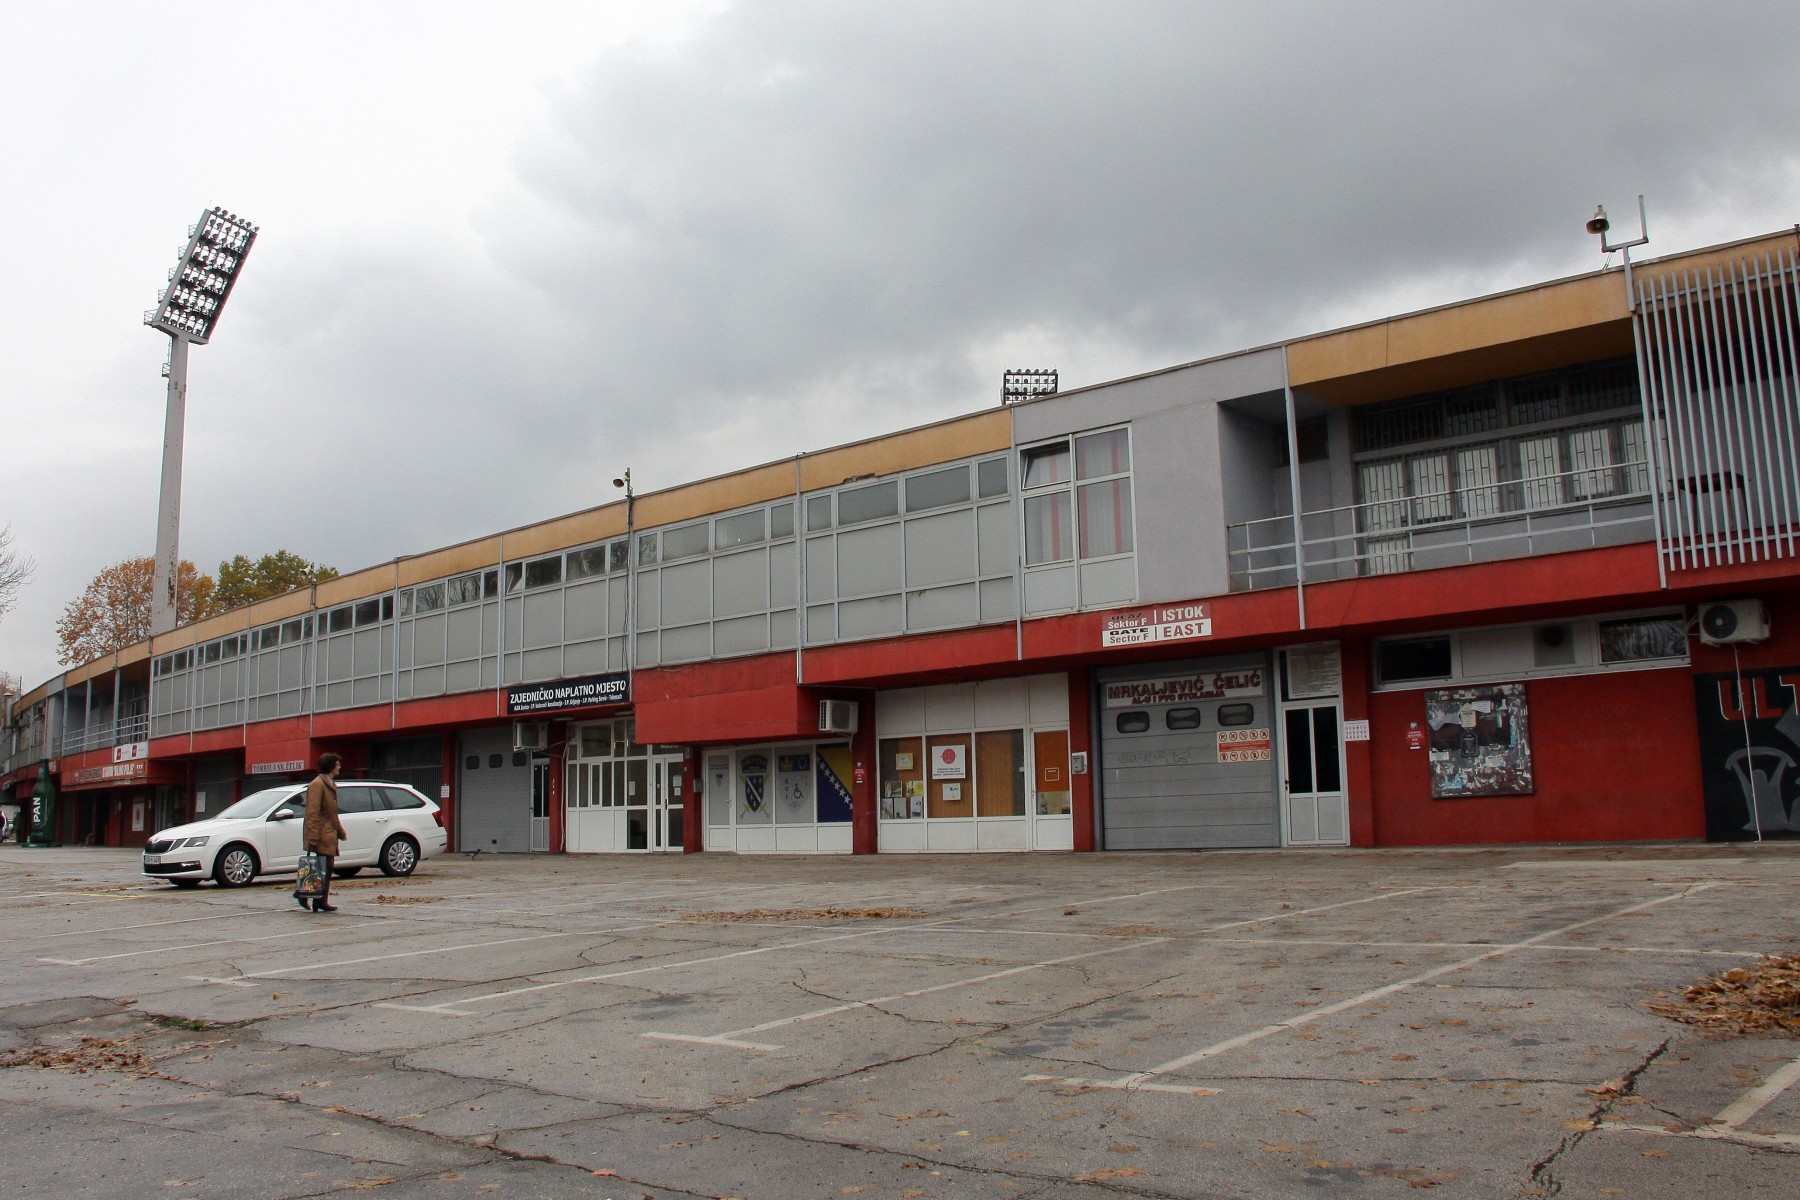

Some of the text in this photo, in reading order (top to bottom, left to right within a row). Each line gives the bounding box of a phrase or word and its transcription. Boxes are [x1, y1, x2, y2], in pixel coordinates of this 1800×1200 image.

[1162, 605, 1204, 622] ISTOK
[1107, 617, 1147, 630] Sektor F
[1109, 627, 1149, 636] GATE
[1163, 622, 1204, 638] EAST
[1109, 632, 1149, 644] Sector F
[510, 680, 627, 704] ZAJEDNIČKO NAPLATNO MJESTO
[1108, 670, 1261, 700] MRKALJEVIĆ ČELIĆ
[33, 797, 41, 823] PAN
